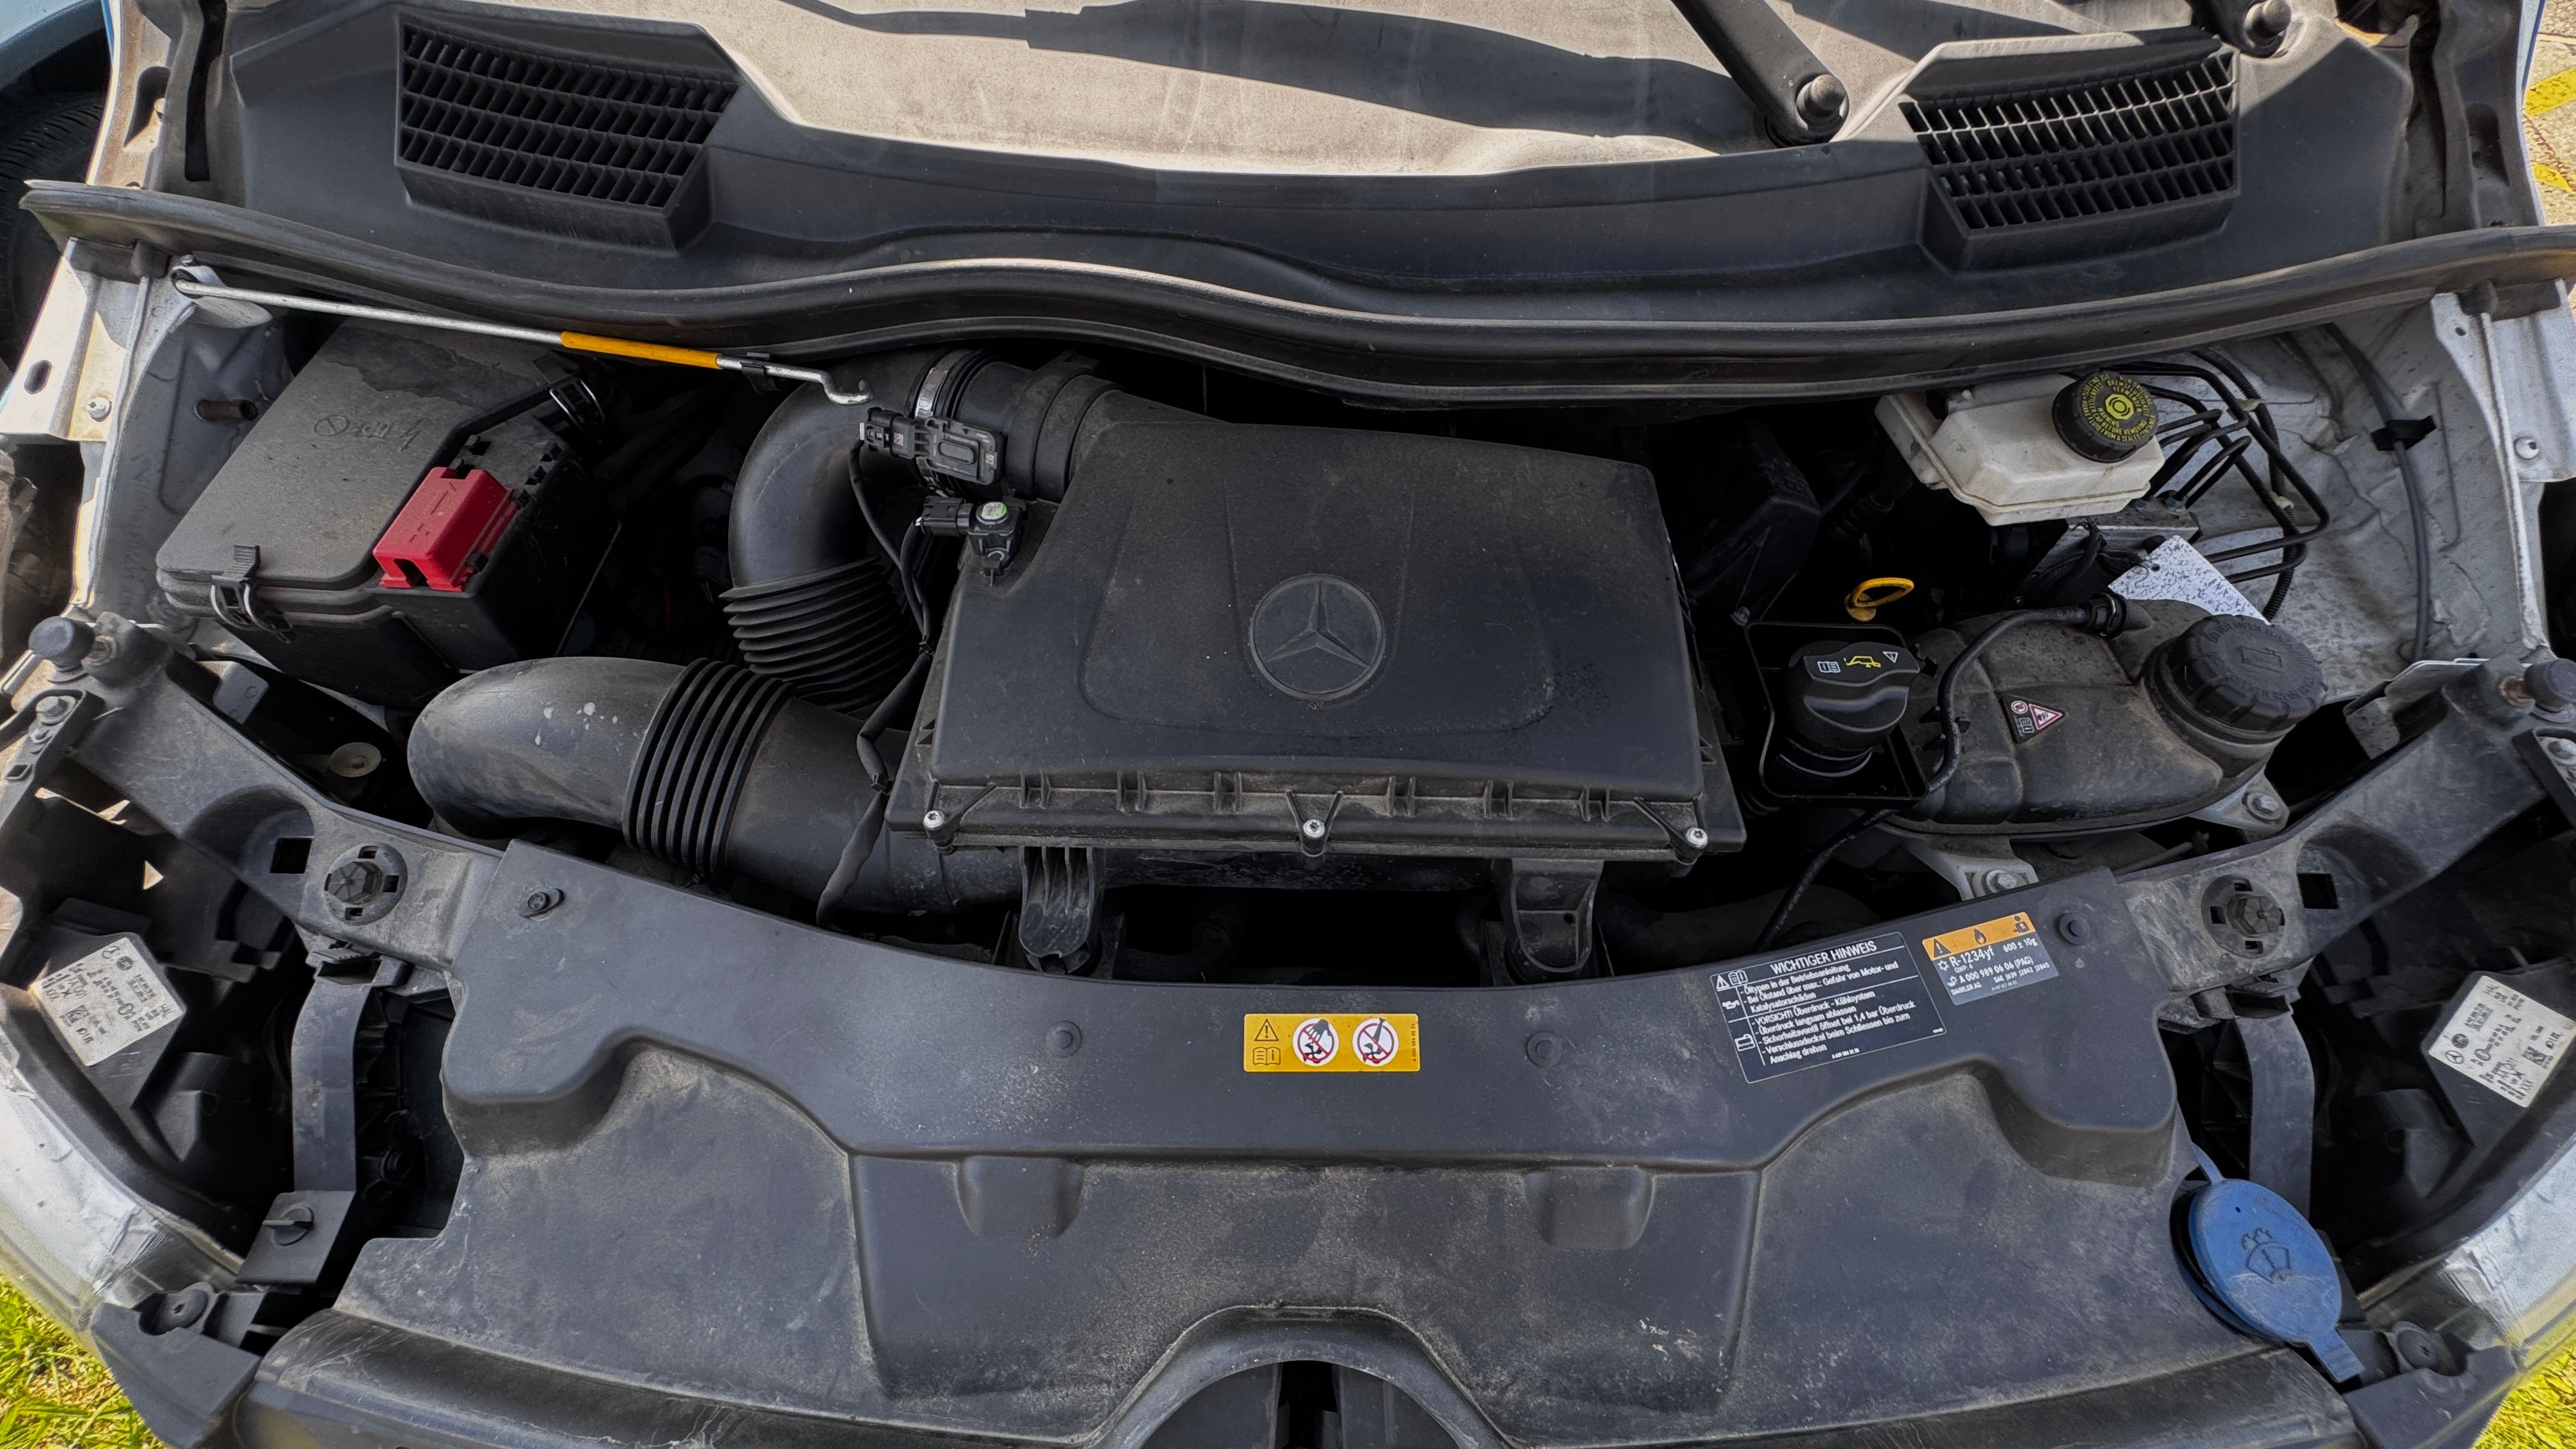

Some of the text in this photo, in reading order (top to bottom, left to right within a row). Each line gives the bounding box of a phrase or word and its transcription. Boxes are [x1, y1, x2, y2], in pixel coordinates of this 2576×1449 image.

[2100, 429, 2115, 440] FROM
[1949, 945, 1995, 967] R-1234yf
[2003, 942, 2018, 953] 600
[2023, 937, 2038, 947] 10g
[1770, 940, 1877, 974] WICHTIGER HINWEIS
[1778, 978, 1790, 987] der
[1790, 964, 1851, 984] Betriebsanleitung
[1822, 974, 1846, 986] Gefahr
[1846, 971, 1860, 980] von
[1860, 966, 1884, 976] Motor-
[1884, 960, 1899, 971] und
[1959, 956, 2034, 984] A 000 989 06 06 (PAG)
[1793, 1001, 1830, 1016] Überdruck
[1853, 1013, 1866, 1022] 1,4
[1865, 1010, 1878, 1019] bar
[1878, 1000, 1916, 1015] Überdruck
[1758, 1020, 1795, 1035] Überdruck
[1825, 1006, 1857, 1019] ablassen
[1825, 1029, 1845, 1039] beim
[1882, 1016, 1895, 1025] bis
[1894, 1013, 1910, 1022] zum
[1770, 1044, 1827, 1064] Anschlag drehen
